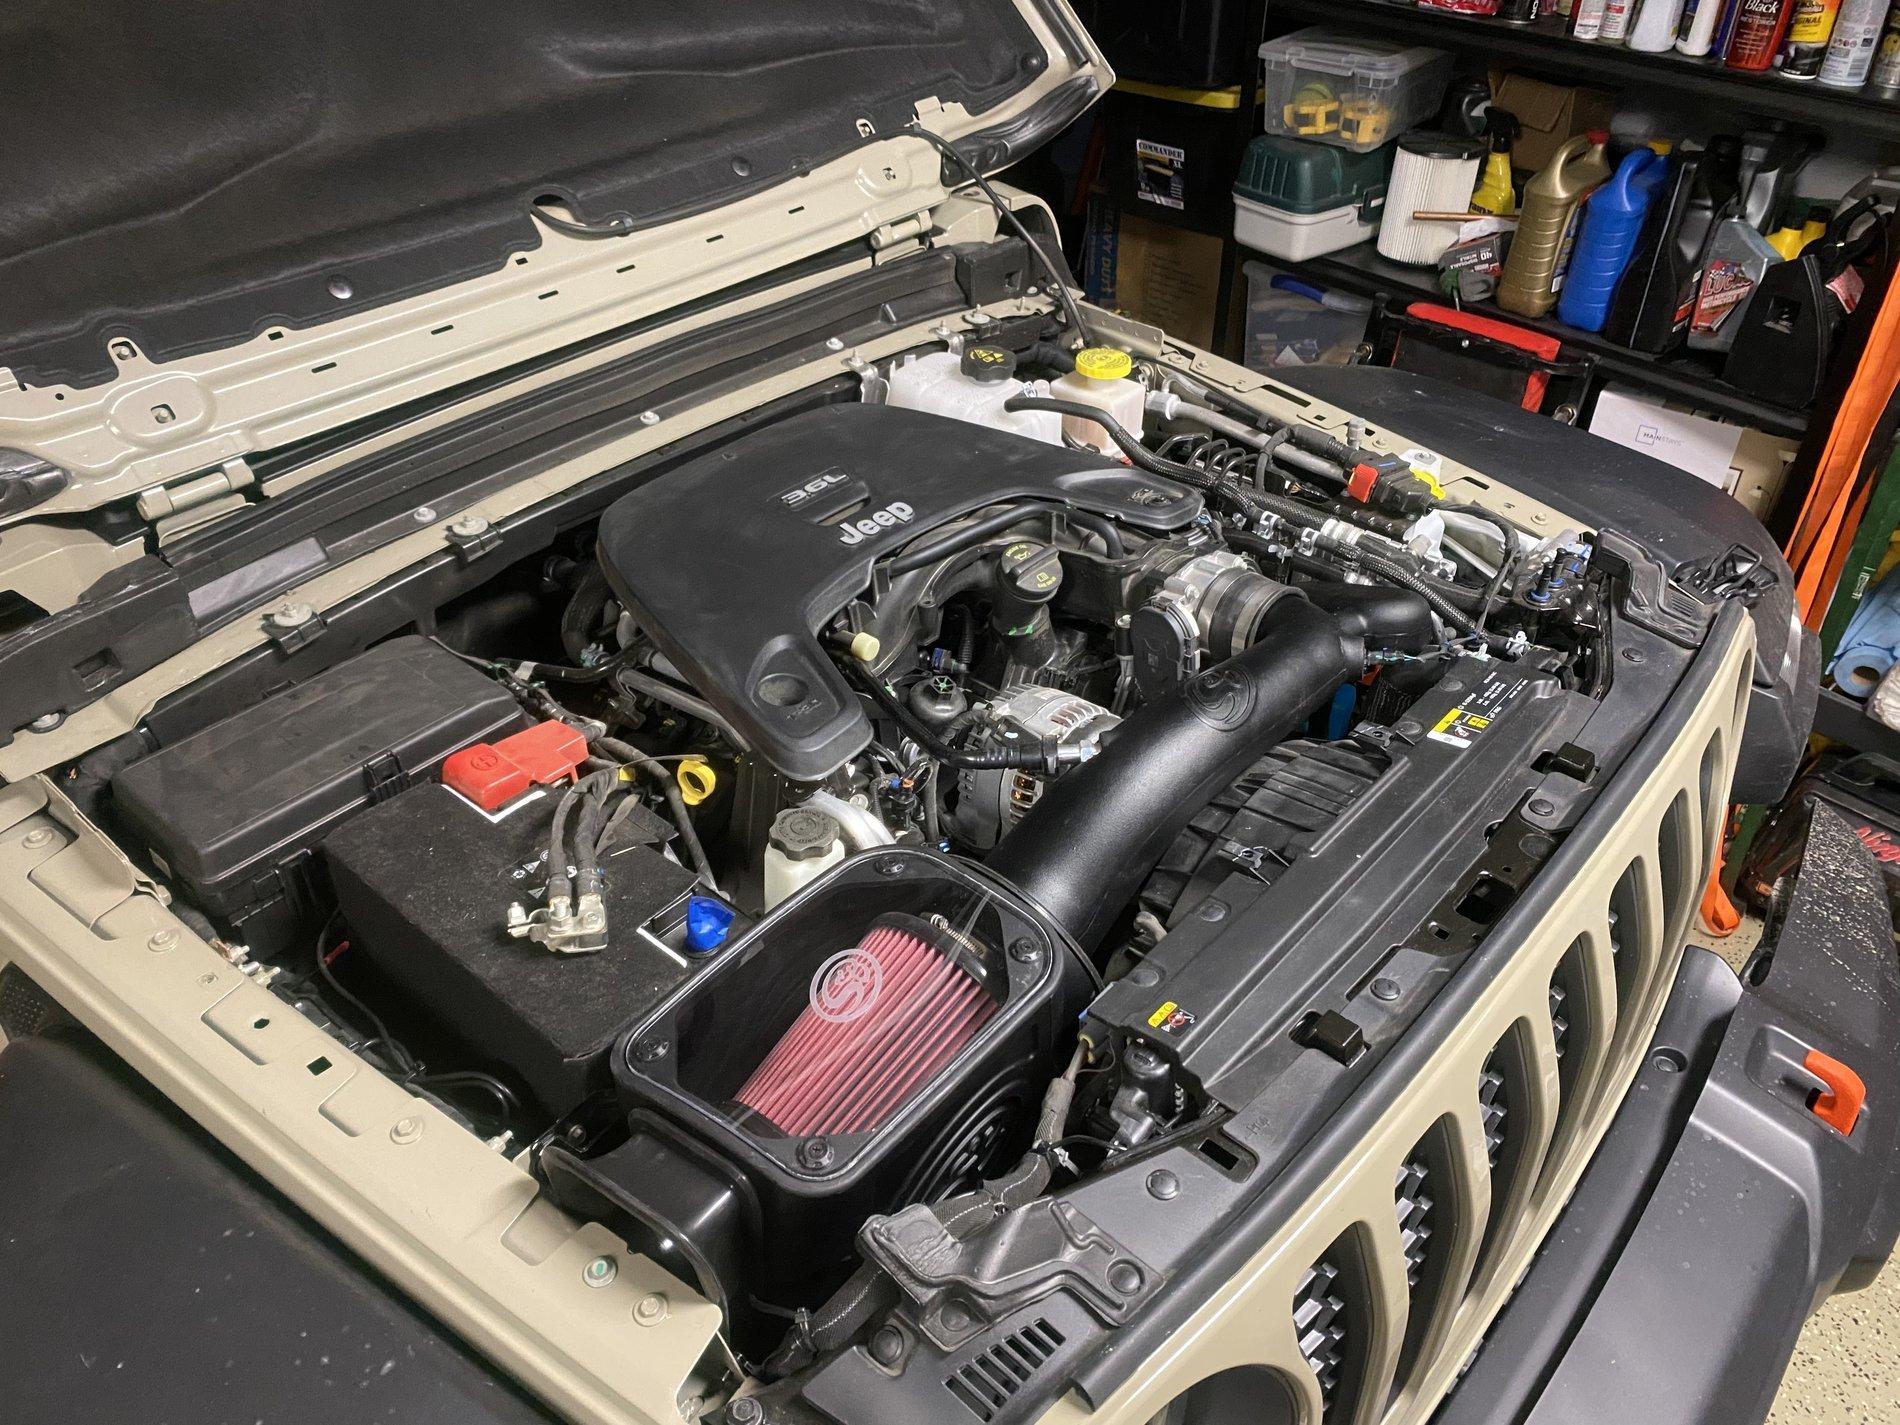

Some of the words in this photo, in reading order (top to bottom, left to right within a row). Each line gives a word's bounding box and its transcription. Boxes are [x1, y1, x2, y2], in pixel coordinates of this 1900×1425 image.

[1744, 0, 1779, 14] Black
[1138, 142, 1183, 159] COMMANDER
[781, 474, 847, 505] 3.6L
[839, 501, 915, 545] Jeep
